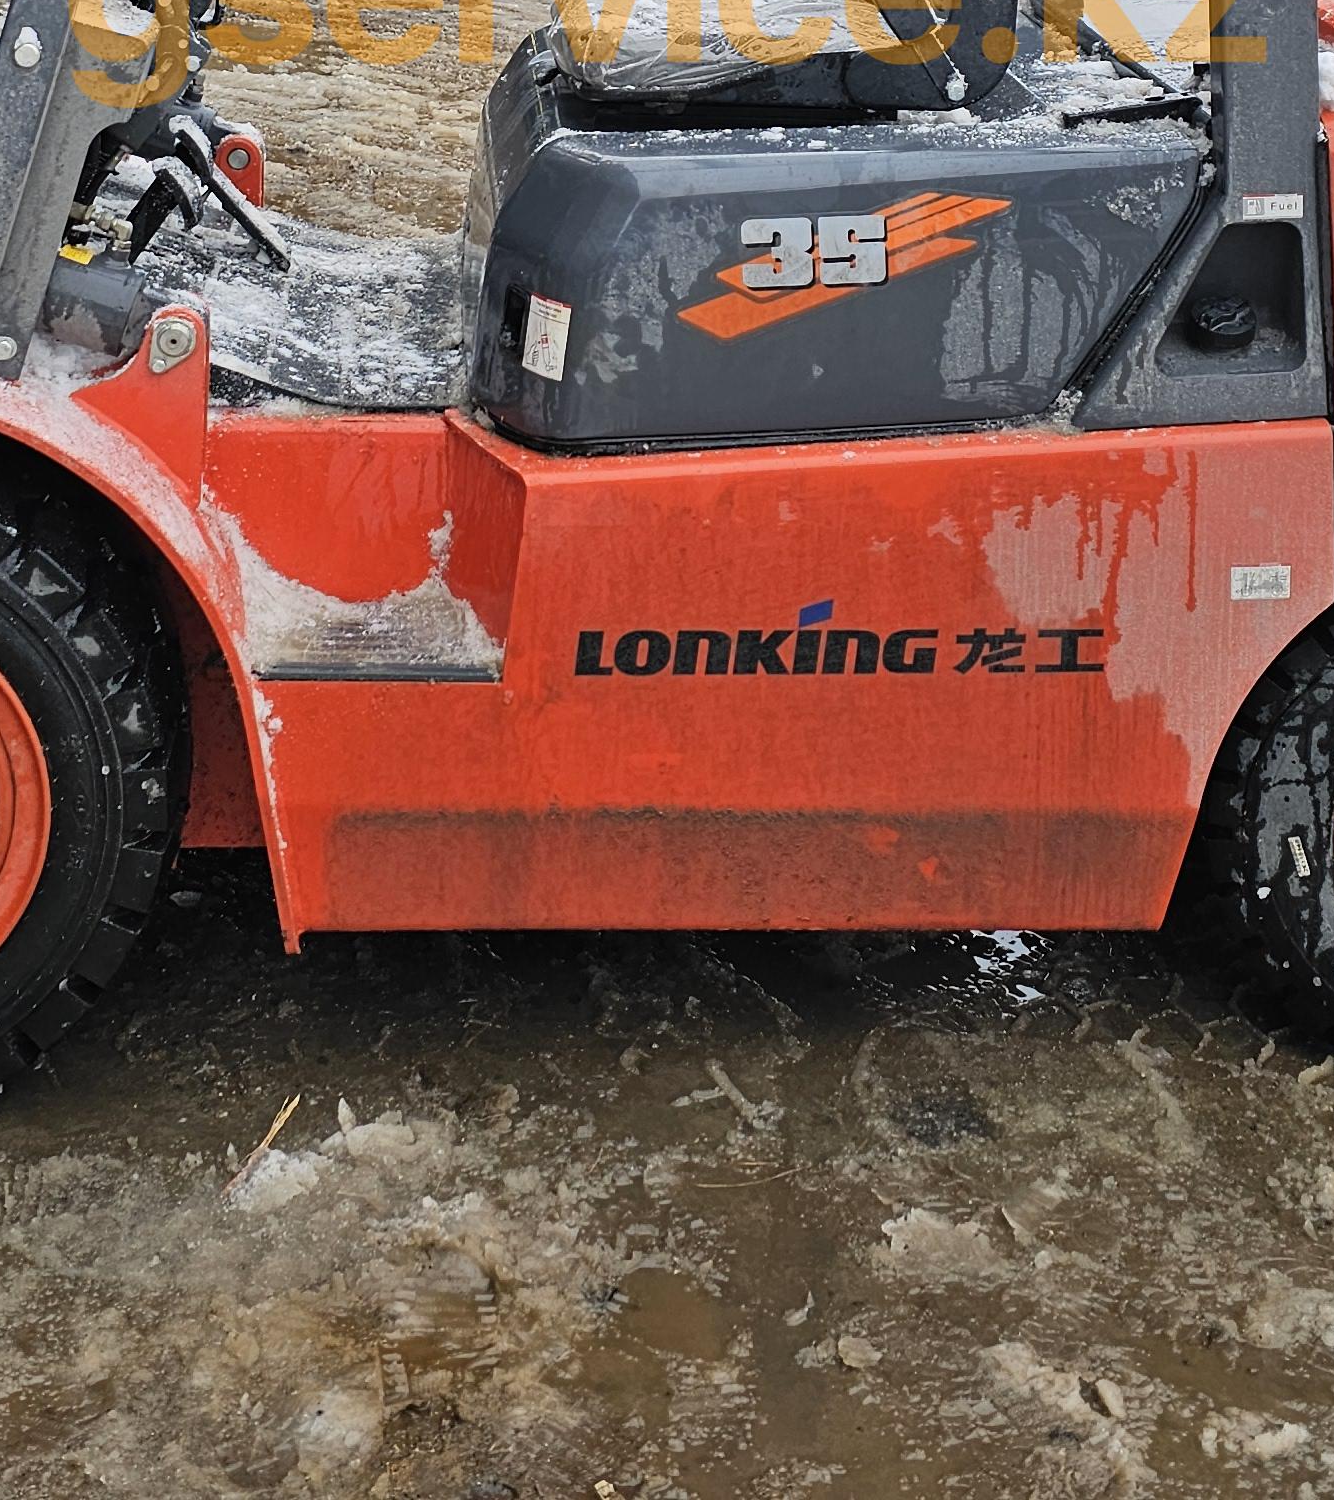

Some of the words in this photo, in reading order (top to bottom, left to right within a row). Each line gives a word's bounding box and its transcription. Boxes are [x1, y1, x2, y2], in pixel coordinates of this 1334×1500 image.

[1270, 201, 1298, 211] Fuel
[739, 214, 887, 288] 35
[953, 626, 1106, 675] 龙工
